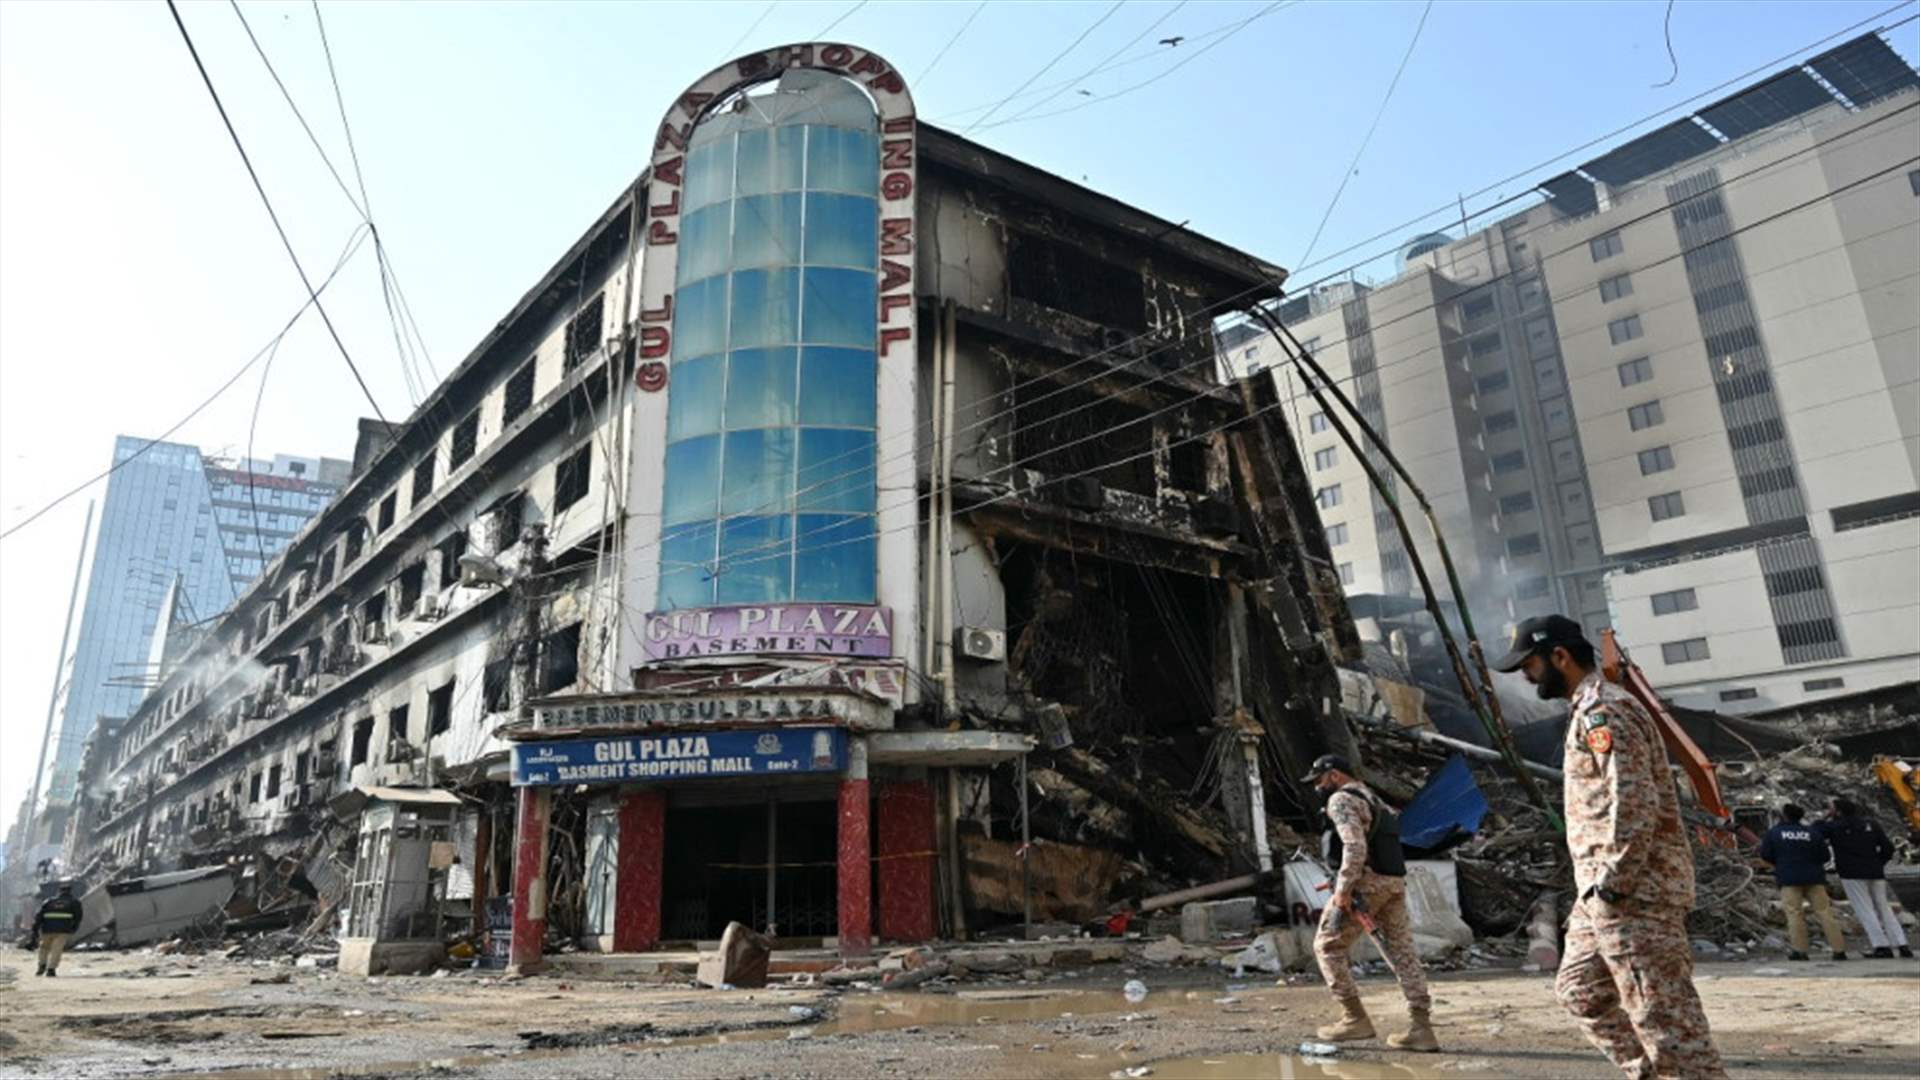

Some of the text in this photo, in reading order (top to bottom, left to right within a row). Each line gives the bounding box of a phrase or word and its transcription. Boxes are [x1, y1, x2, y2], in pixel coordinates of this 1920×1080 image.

[649, 91, 714, 247] PLAZA
[878, 217, 914, 358] MALL
[634, 294, 672, 393] GUL
[647, 606, 890, 641] GUL PLAZA
[664, 637, 864, 657] BASEMENT
[594, 736, 711, 763] GUL PLAZA
[628, 757, 708, 777] SHOPPING
[710, 757, 752, 772] MALL
[1781, 830, 1811, 841] POLICE
